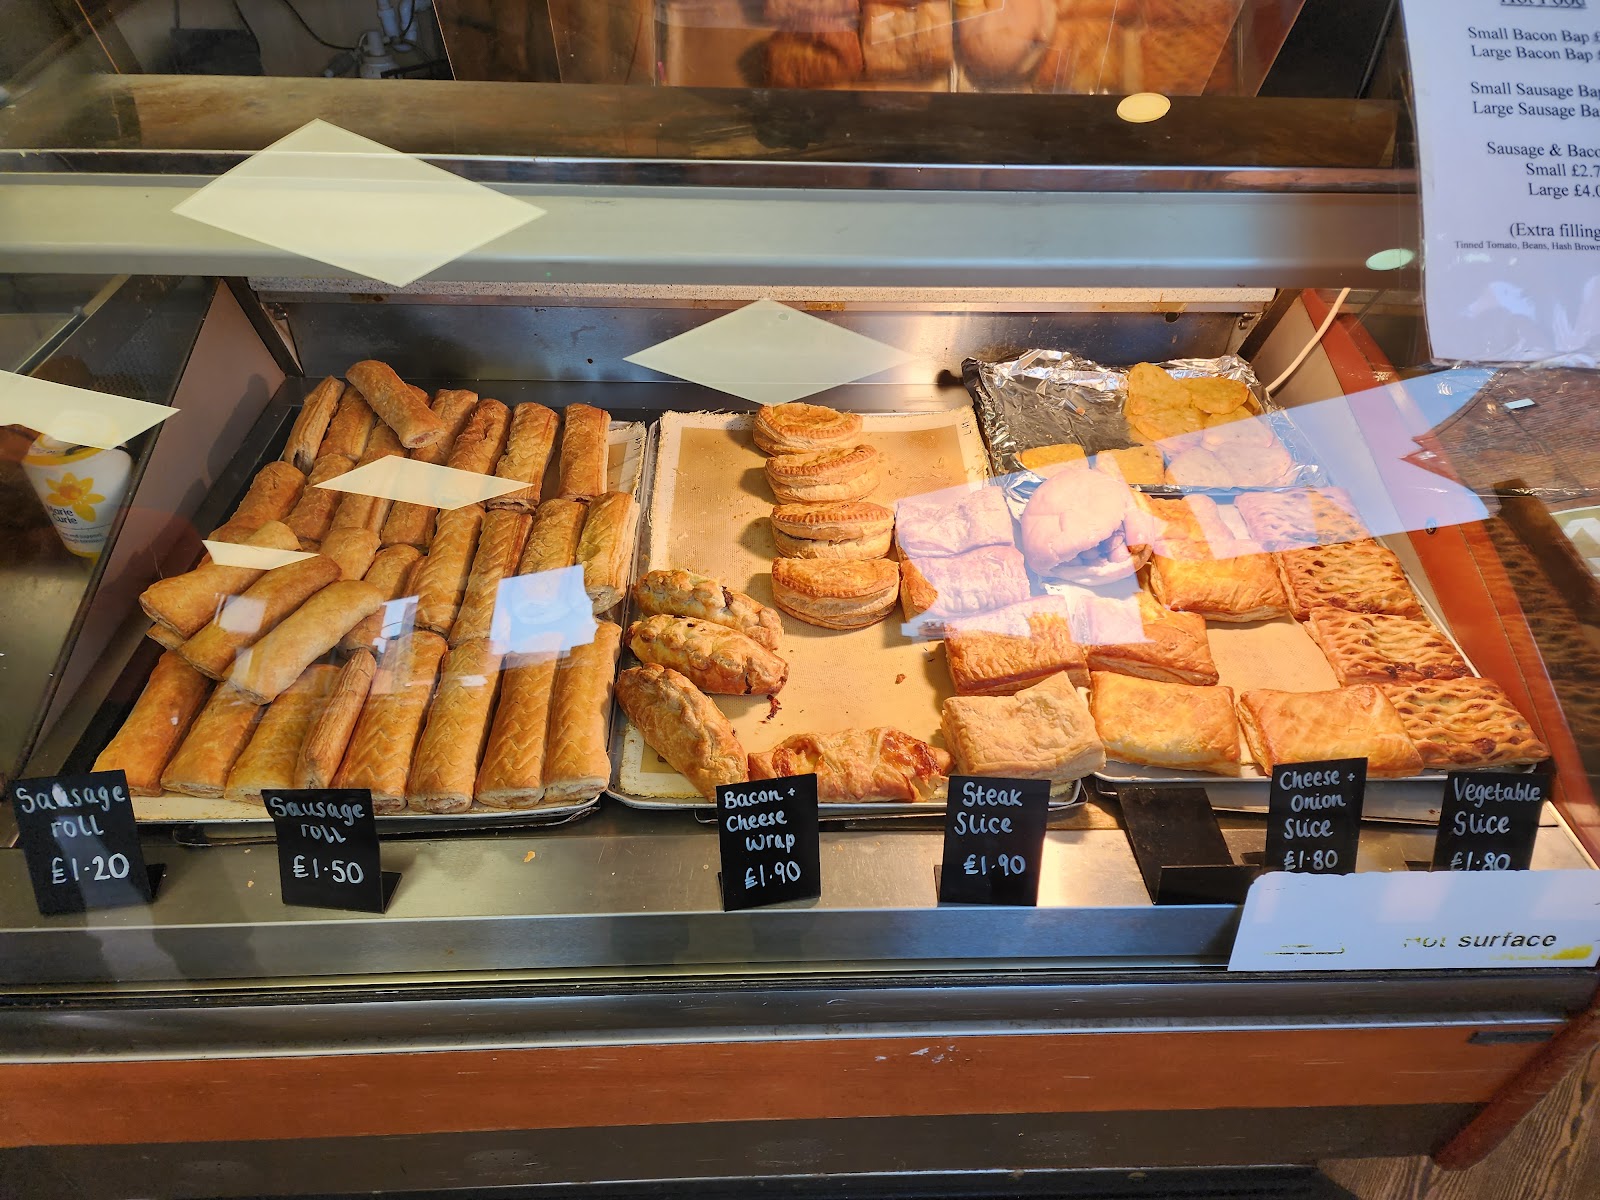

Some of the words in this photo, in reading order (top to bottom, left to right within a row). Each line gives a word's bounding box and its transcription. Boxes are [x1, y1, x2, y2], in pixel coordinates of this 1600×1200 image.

[1468, 26, 1509, 41] Small
[1513, 28, 1558, 42] Bacon
[1561, 29, 1590, 45] Bap
[1471, 45, 1512, 61] Large
[1516, 46, 1561, 60] Bacon
[1565, 48, 1594, 63] Bap
[1470, 81, 1512, 95] Small
[1516, 83, 1574, 100] Sausage
[1578, 84, 1600, 101] Ba
[1473, 101, 1514, 118] Large
[1518, 102, 1576, 120] Sausage
[1487, 141, 1545, 159] Sausage
[1549, 143, 1562, 157] &
[1526, 162, 1567, 177] Small
[1528, 182, 1569, 200] Large
[1510, 222, 1555, 239] (Extra
[1455, 240, 1484, 249] Tinned
[1486, 240, 1520, 251] Tomato,
[1522, 241, 1550, 252] Beans,
[1552, 242, 1572, 251] Hash
[52, 513, 78, 525] Curie
[1280, 770, 1341, 791] Cheese
[15, 783, 126, 814] Sausage
[724, 789, 784, 810] Bacon
[962, 781, 1023, 808] Steak
[1290, 793, 1347, 813] Onion
[1453, 777, 1541, 809] Vegetable
[269, 796, 365, 827] Sausage
[726, 810, 788, 833] Cheese
[50, 814, 105, 838] roll
[300, 823, 347, 844] roll
[953, 811, 1013, 836] Slice
[1283, 818, 1334, 840] Slice
[1452, 810, 1511, 837] Slice
[1457, 932, 1557, 949] surface
